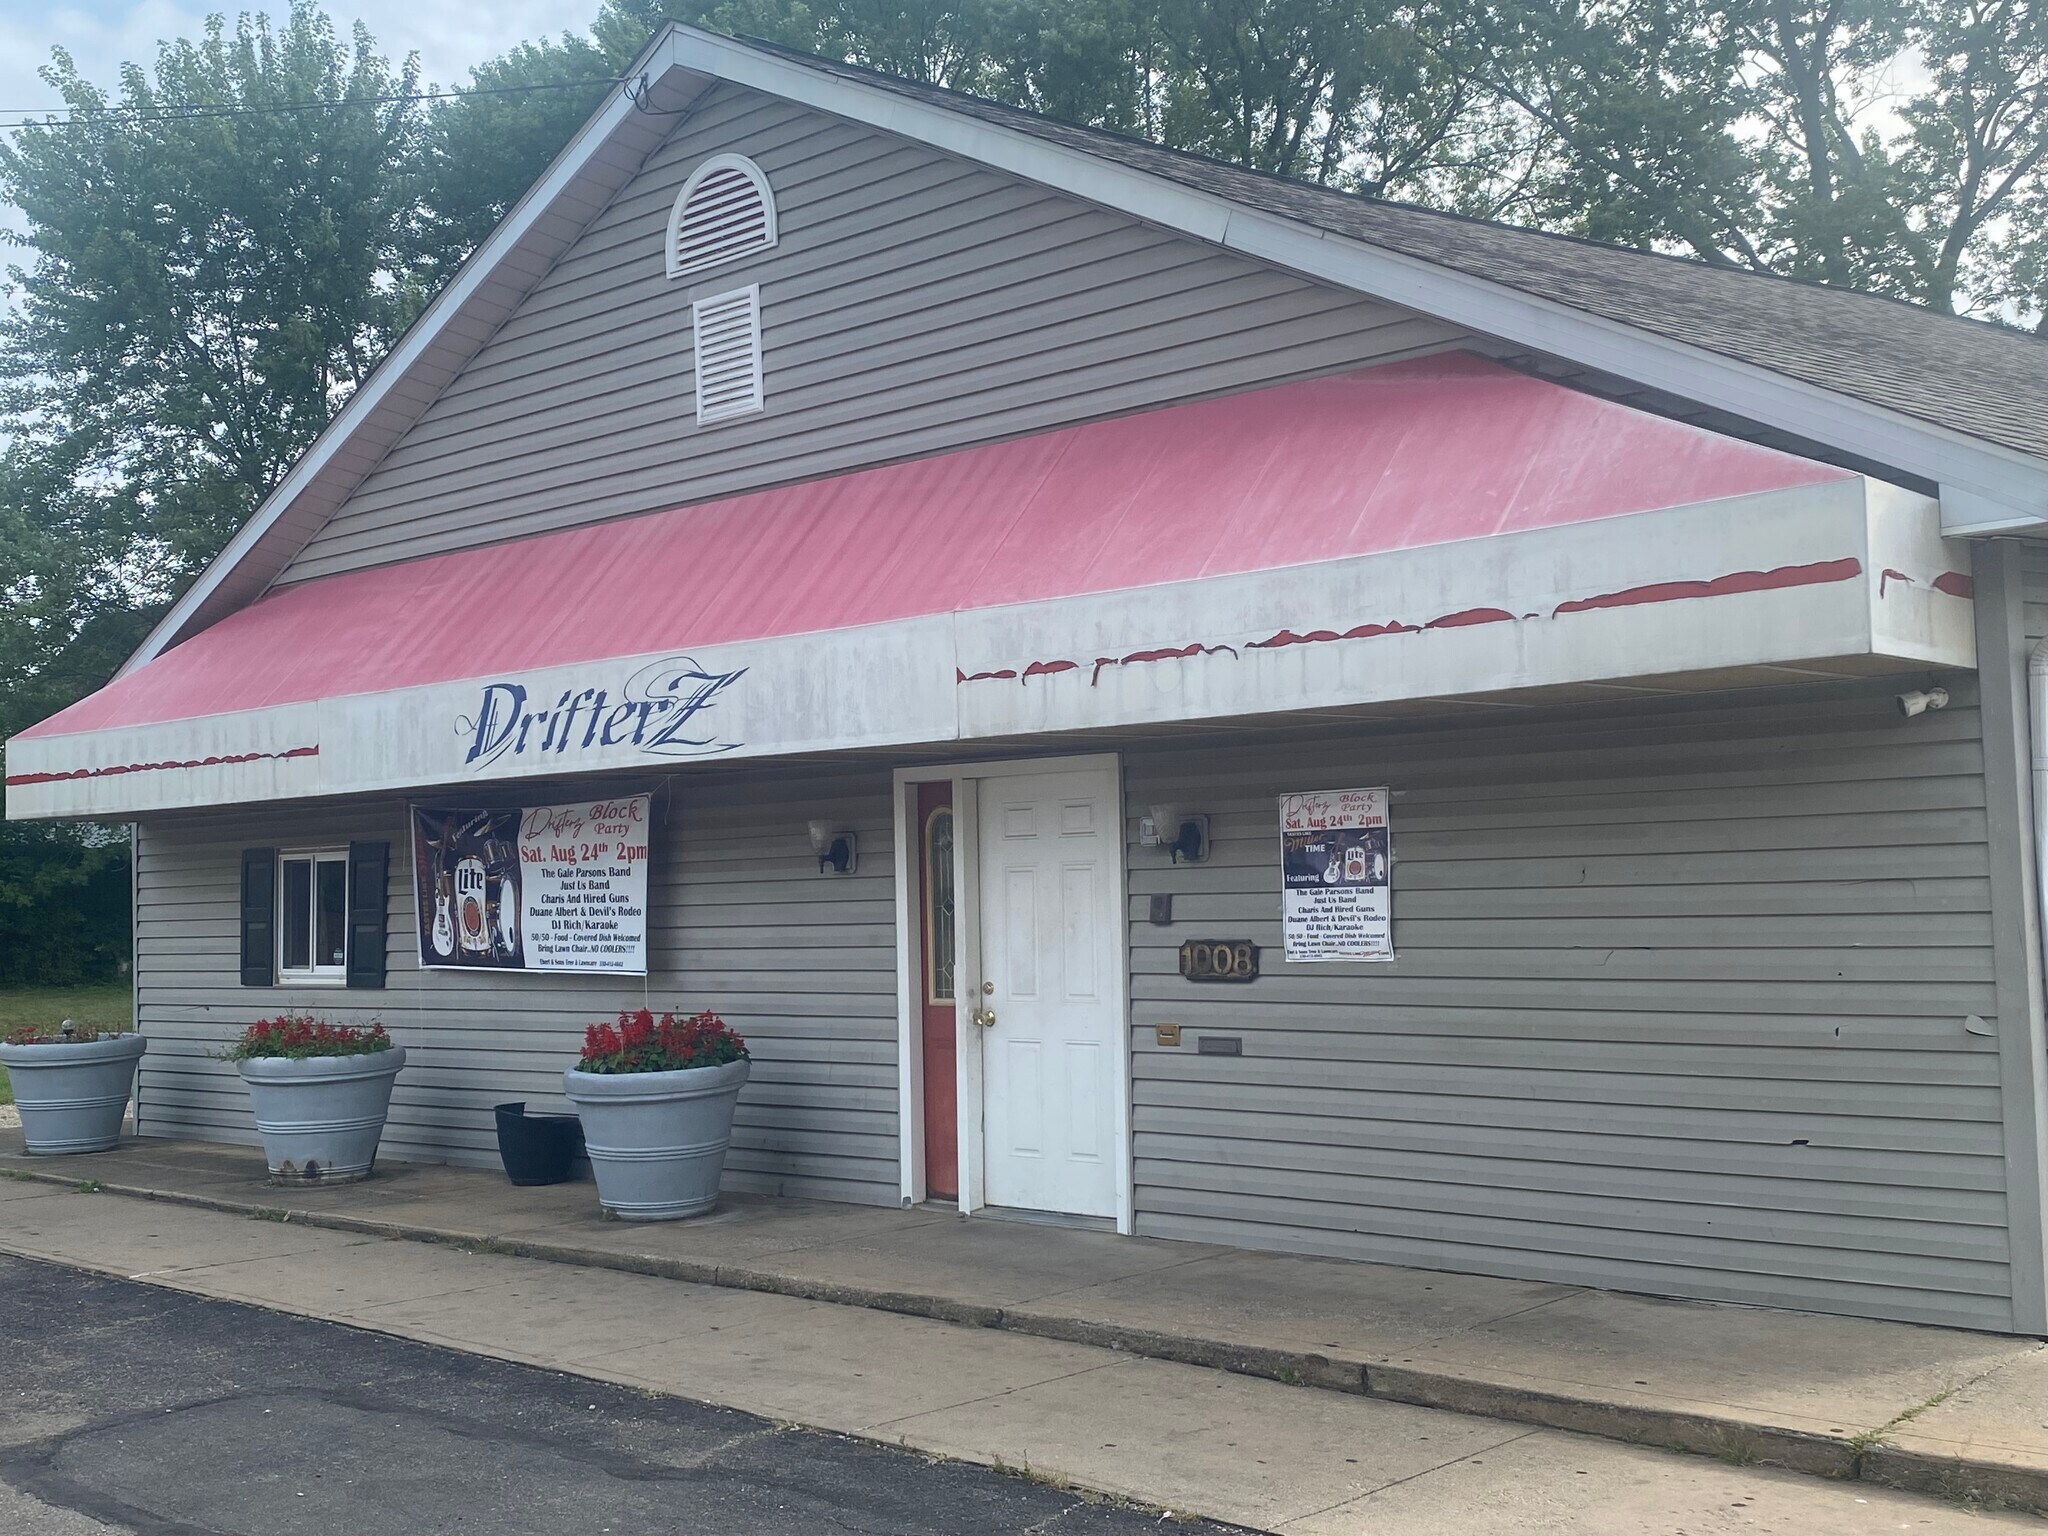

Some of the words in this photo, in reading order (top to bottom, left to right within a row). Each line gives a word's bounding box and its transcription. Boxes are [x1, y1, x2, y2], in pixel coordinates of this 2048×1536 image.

[1339, 792, 1376, 803] Block
[589, 799, 643, 822] Block
[1340, 802, 1373, 814] Party
[451, 809, 489, 843] Featuring
[1285, 818, 1304, 829] Sat.
[1306, 817, 1327, 829] Aug
[1329, 813, 1353, 827] 24th
[1358, 813, 1382, 827] 2pm
[594, 822, 630, 838] Party
[521, 845, 546, 863] Sat.
[550, 844, 577, 866] Aug
[580, 842, 608, 861] 24th
[616, 842, 647, 864] 2pm
[1305, 844, 1326, 853] TIME
[1347, 850, 1364, 861] Lite
[541, 868, 555, 878] The
[557, 868, 574, 878] Gale
[576, 867, 606, 878] Parsons
[608, 866, 631, 877] Band
[458, 868, 483, 895] Lite
[1286, 874, 1319, 883] Featuring
[560, 880, 575, 890] Just
[577, 880, 587, 890] Us
[588, 879, 610, 890] Band
[1355, 887, 1374, 895] Band
[541, 893, 564, 904] Charis
[566, 894, 581, 903] And
[583, 893, 606, 903] Hired
[608, 892, 629, 903] Guns
[1328, 896, 1337, 904] Us
[530, 906, 553, 917] Duane
[555, 906, 578, 917] Albert
[580, 907, 587, 917] &
[589, 906, 616, 917] Devil's
[618, 906, 642, 916] Rodeo
[1298, 906, 1319, 914] Charis
[1334, 905, 1354, 913] Hired
[1363, 914, 1386, 922] Rodeo
[551, 920, 561, 930] DJ
[563, 919, 619, 931] Rich/Karaoke
[554, 933, 568, 942] Food
[573, 933, 597, 942] Covered
[598, 933, 611, 942] Dish
[612, 933, 641, 942] Welcomed
[538, 944, 554, 954] Bring
[555, 944, 570, 953] Lawn
[1181, 943, 1253, 976] 1008
